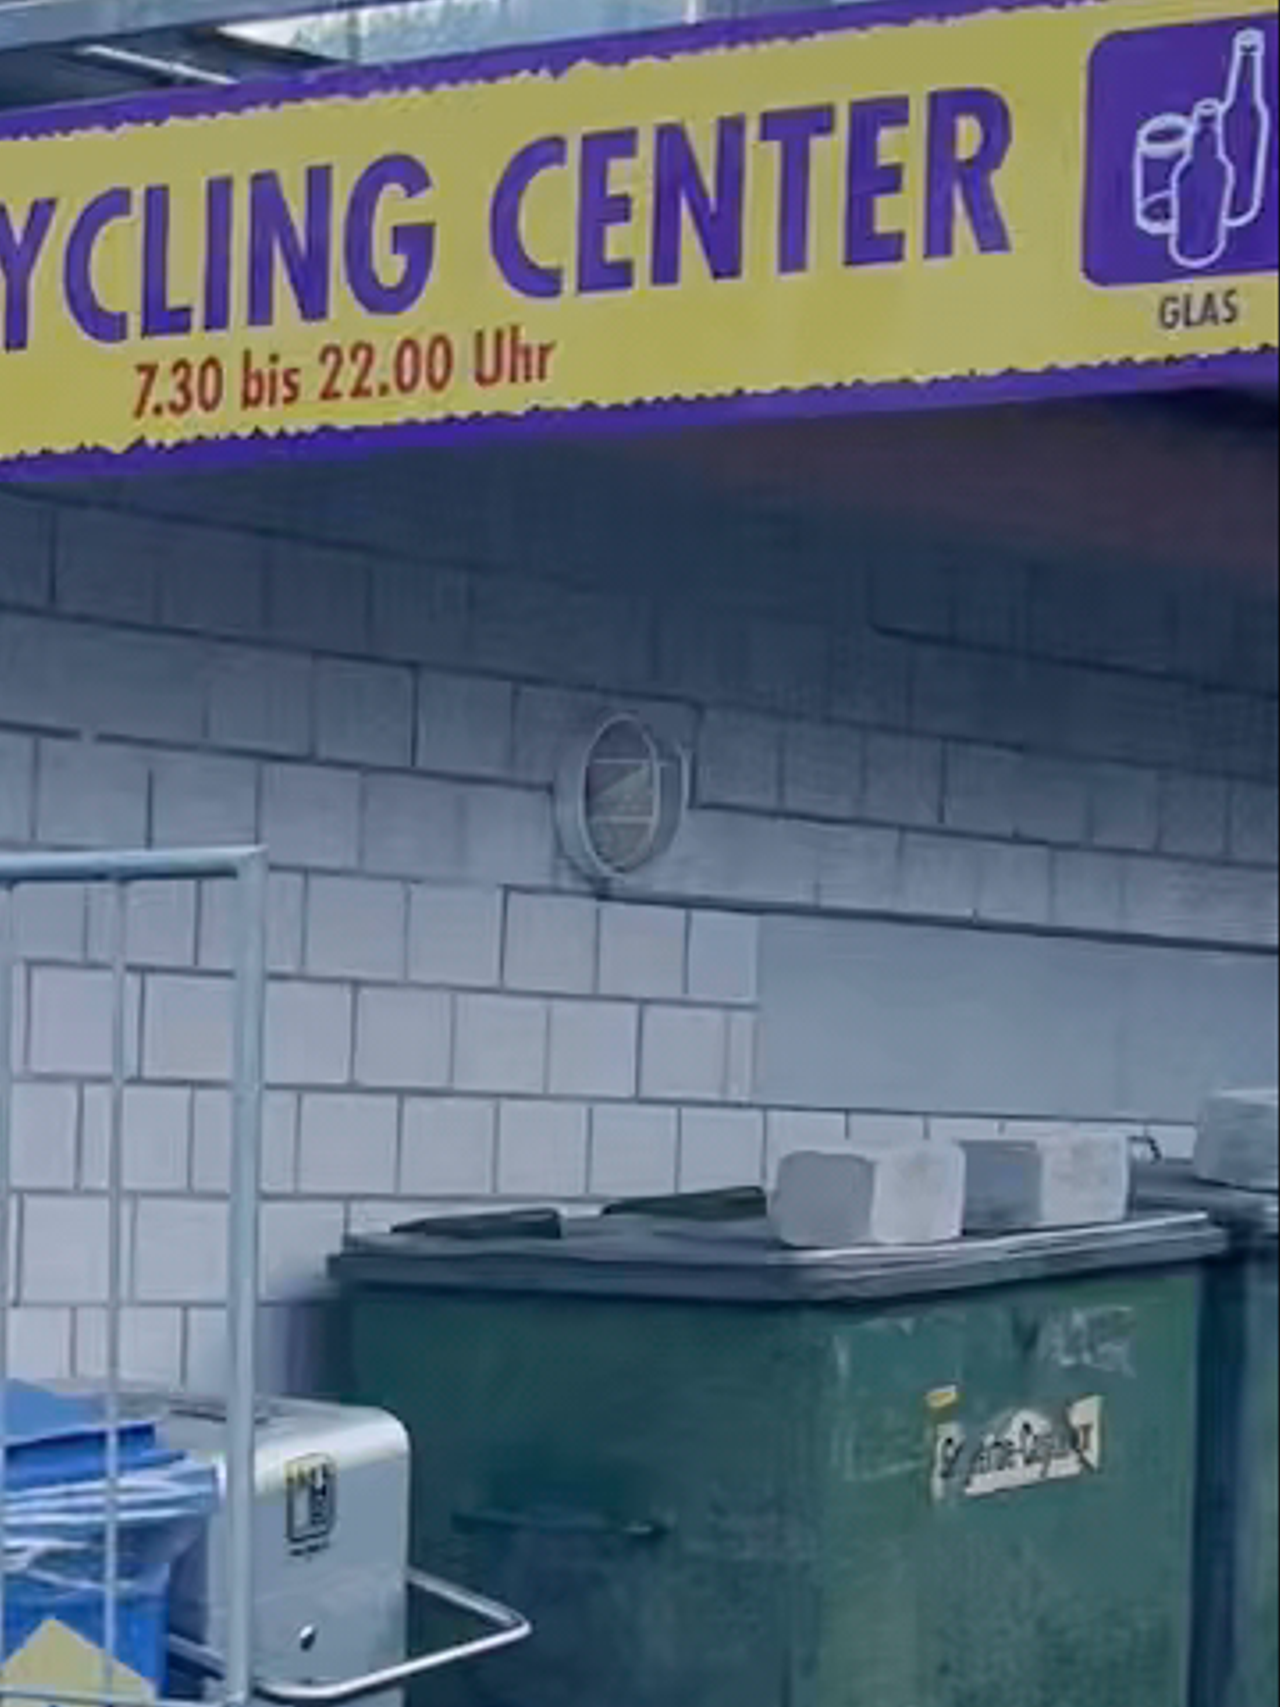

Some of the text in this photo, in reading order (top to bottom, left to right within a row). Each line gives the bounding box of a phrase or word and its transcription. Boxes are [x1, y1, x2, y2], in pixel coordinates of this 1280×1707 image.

[490, 87, 1010, 298] CENTER
[1158, 289, 1238, 330] GLAS
[132, 324, 556, 419] 7.30 bis 22.00 Uhr
